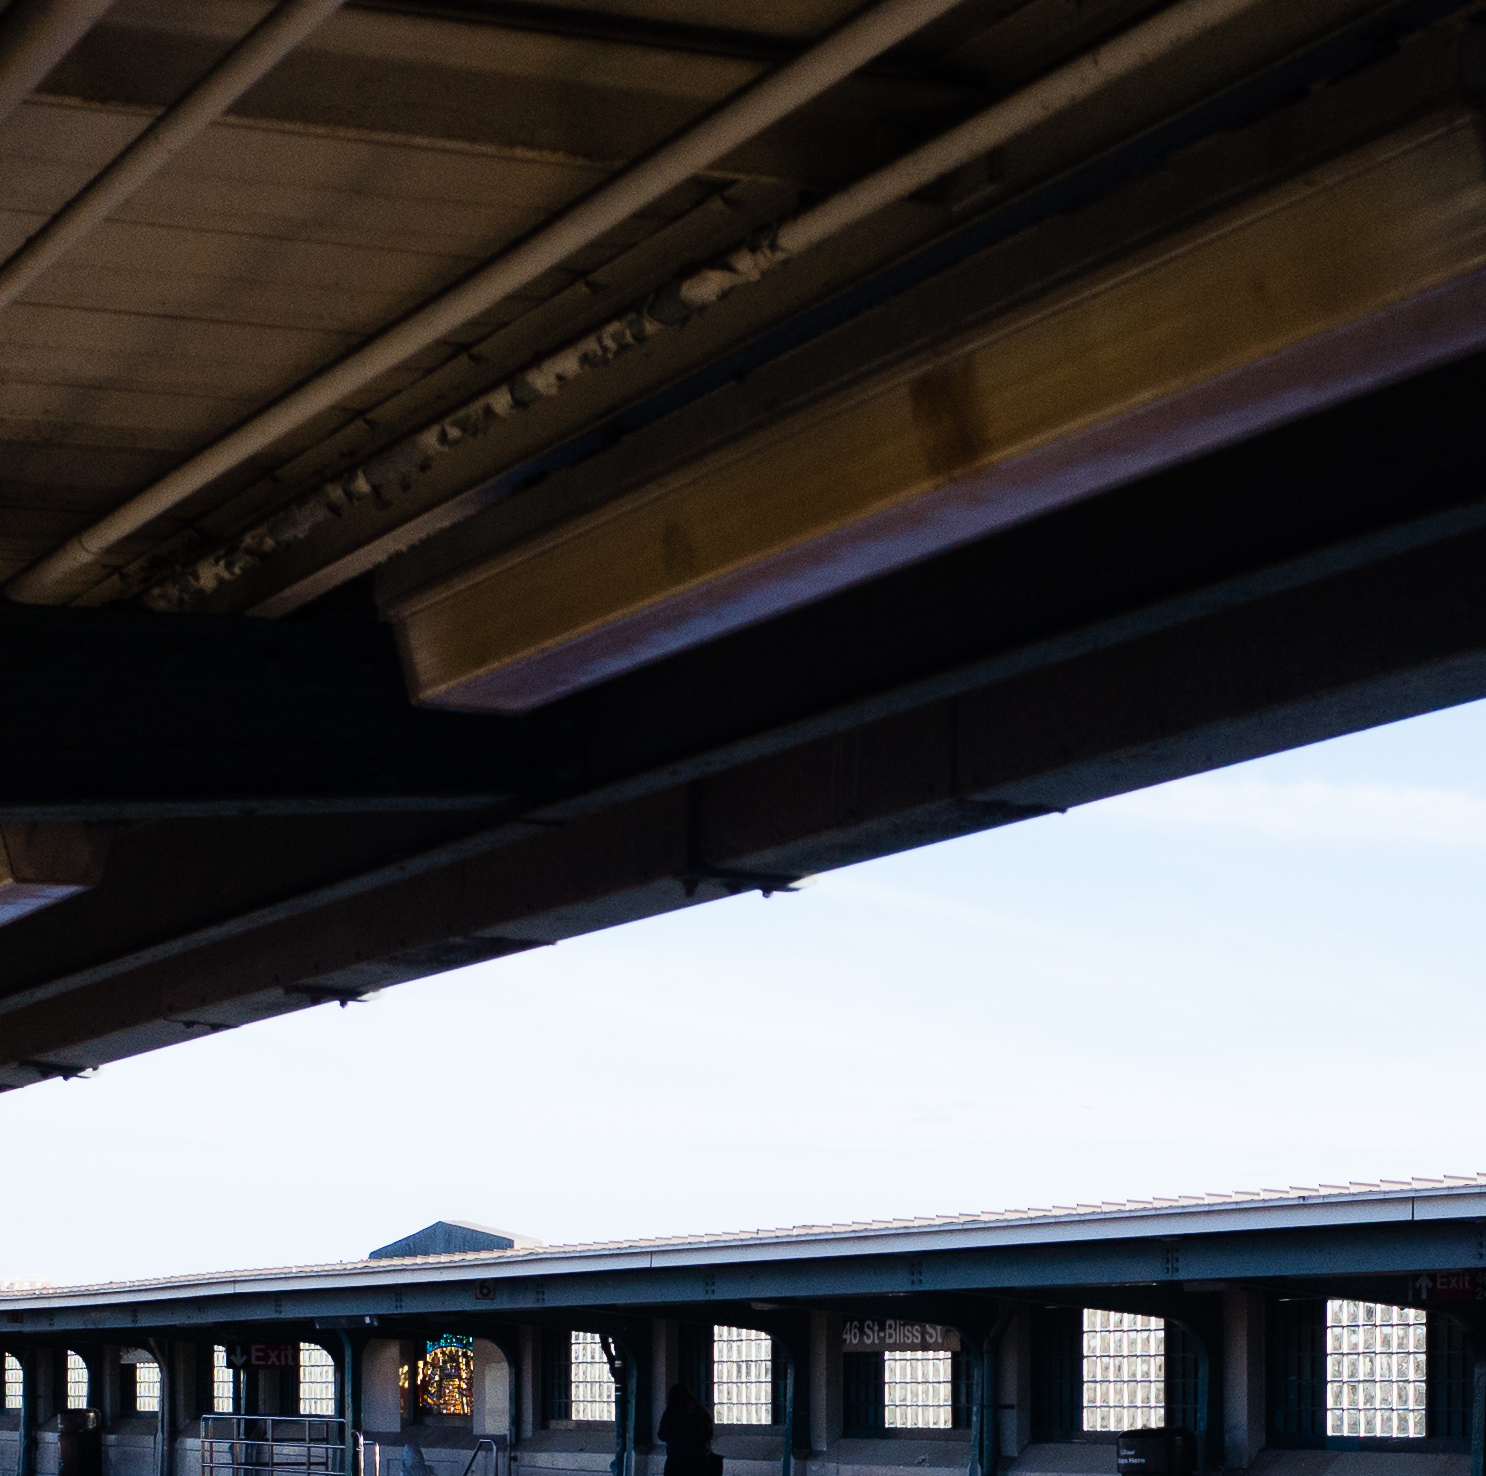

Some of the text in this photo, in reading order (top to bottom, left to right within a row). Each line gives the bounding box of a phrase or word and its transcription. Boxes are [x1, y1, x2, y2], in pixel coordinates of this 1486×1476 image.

[479, 1280, 491, 1298] 6
[1436, 1271, 1472, 1290] Exit
[842, 1320, 943, 1344] 46 St-Bliss St
[251, 1344, 295, 1366] Exit
